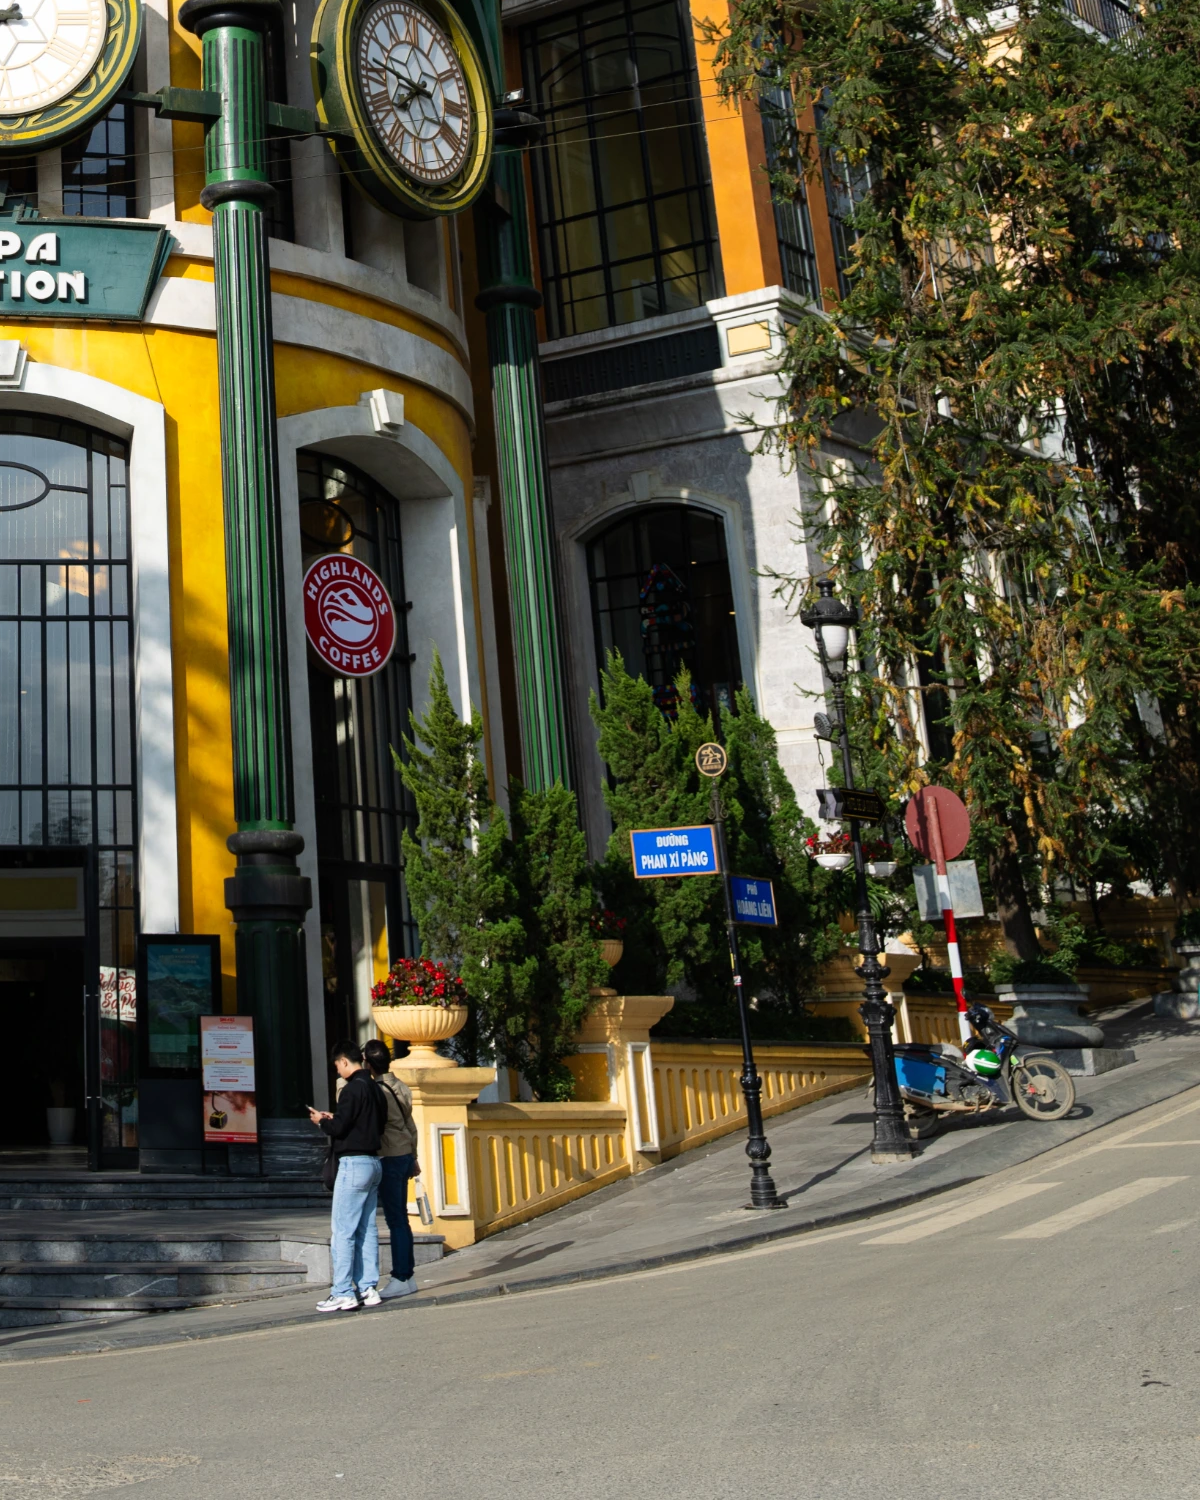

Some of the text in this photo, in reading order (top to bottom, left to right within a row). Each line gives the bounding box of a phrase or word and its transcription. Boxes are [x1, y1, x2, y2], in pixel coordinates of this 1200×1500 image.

[307, 562, 388, 615] HIGHLANDS
[319, 636, 381, 669] COFFEE
[641, 853, 668, 870] PHAN
[680, 849, 709, 867] PĂNG
